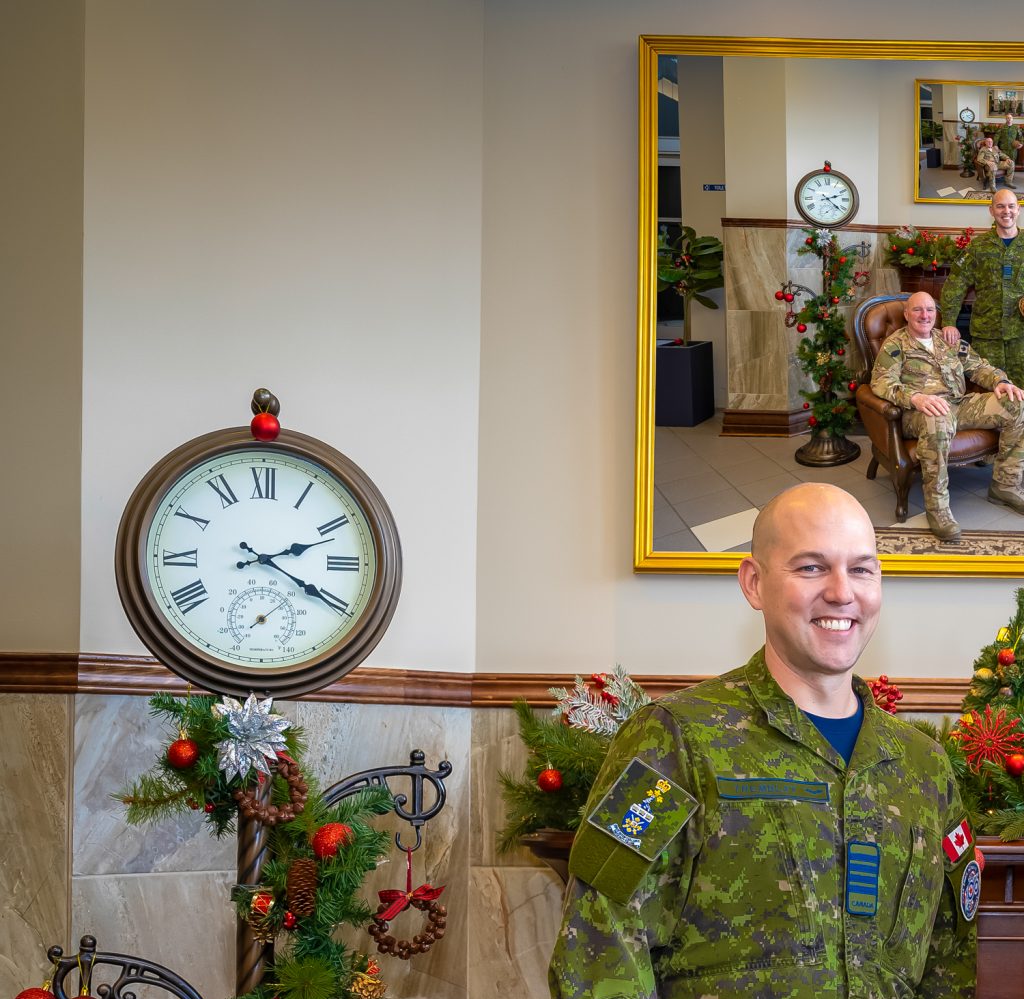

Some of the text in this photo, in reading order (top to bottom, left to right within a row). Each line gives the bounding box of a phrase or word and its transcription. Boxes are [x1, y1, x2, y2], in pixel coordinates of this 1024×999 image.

[249, 467, 278, 501] XII
[174, 505, 210, 531] X
[316, 513, 350, 536] II
[326, 555, 360, 573] III
